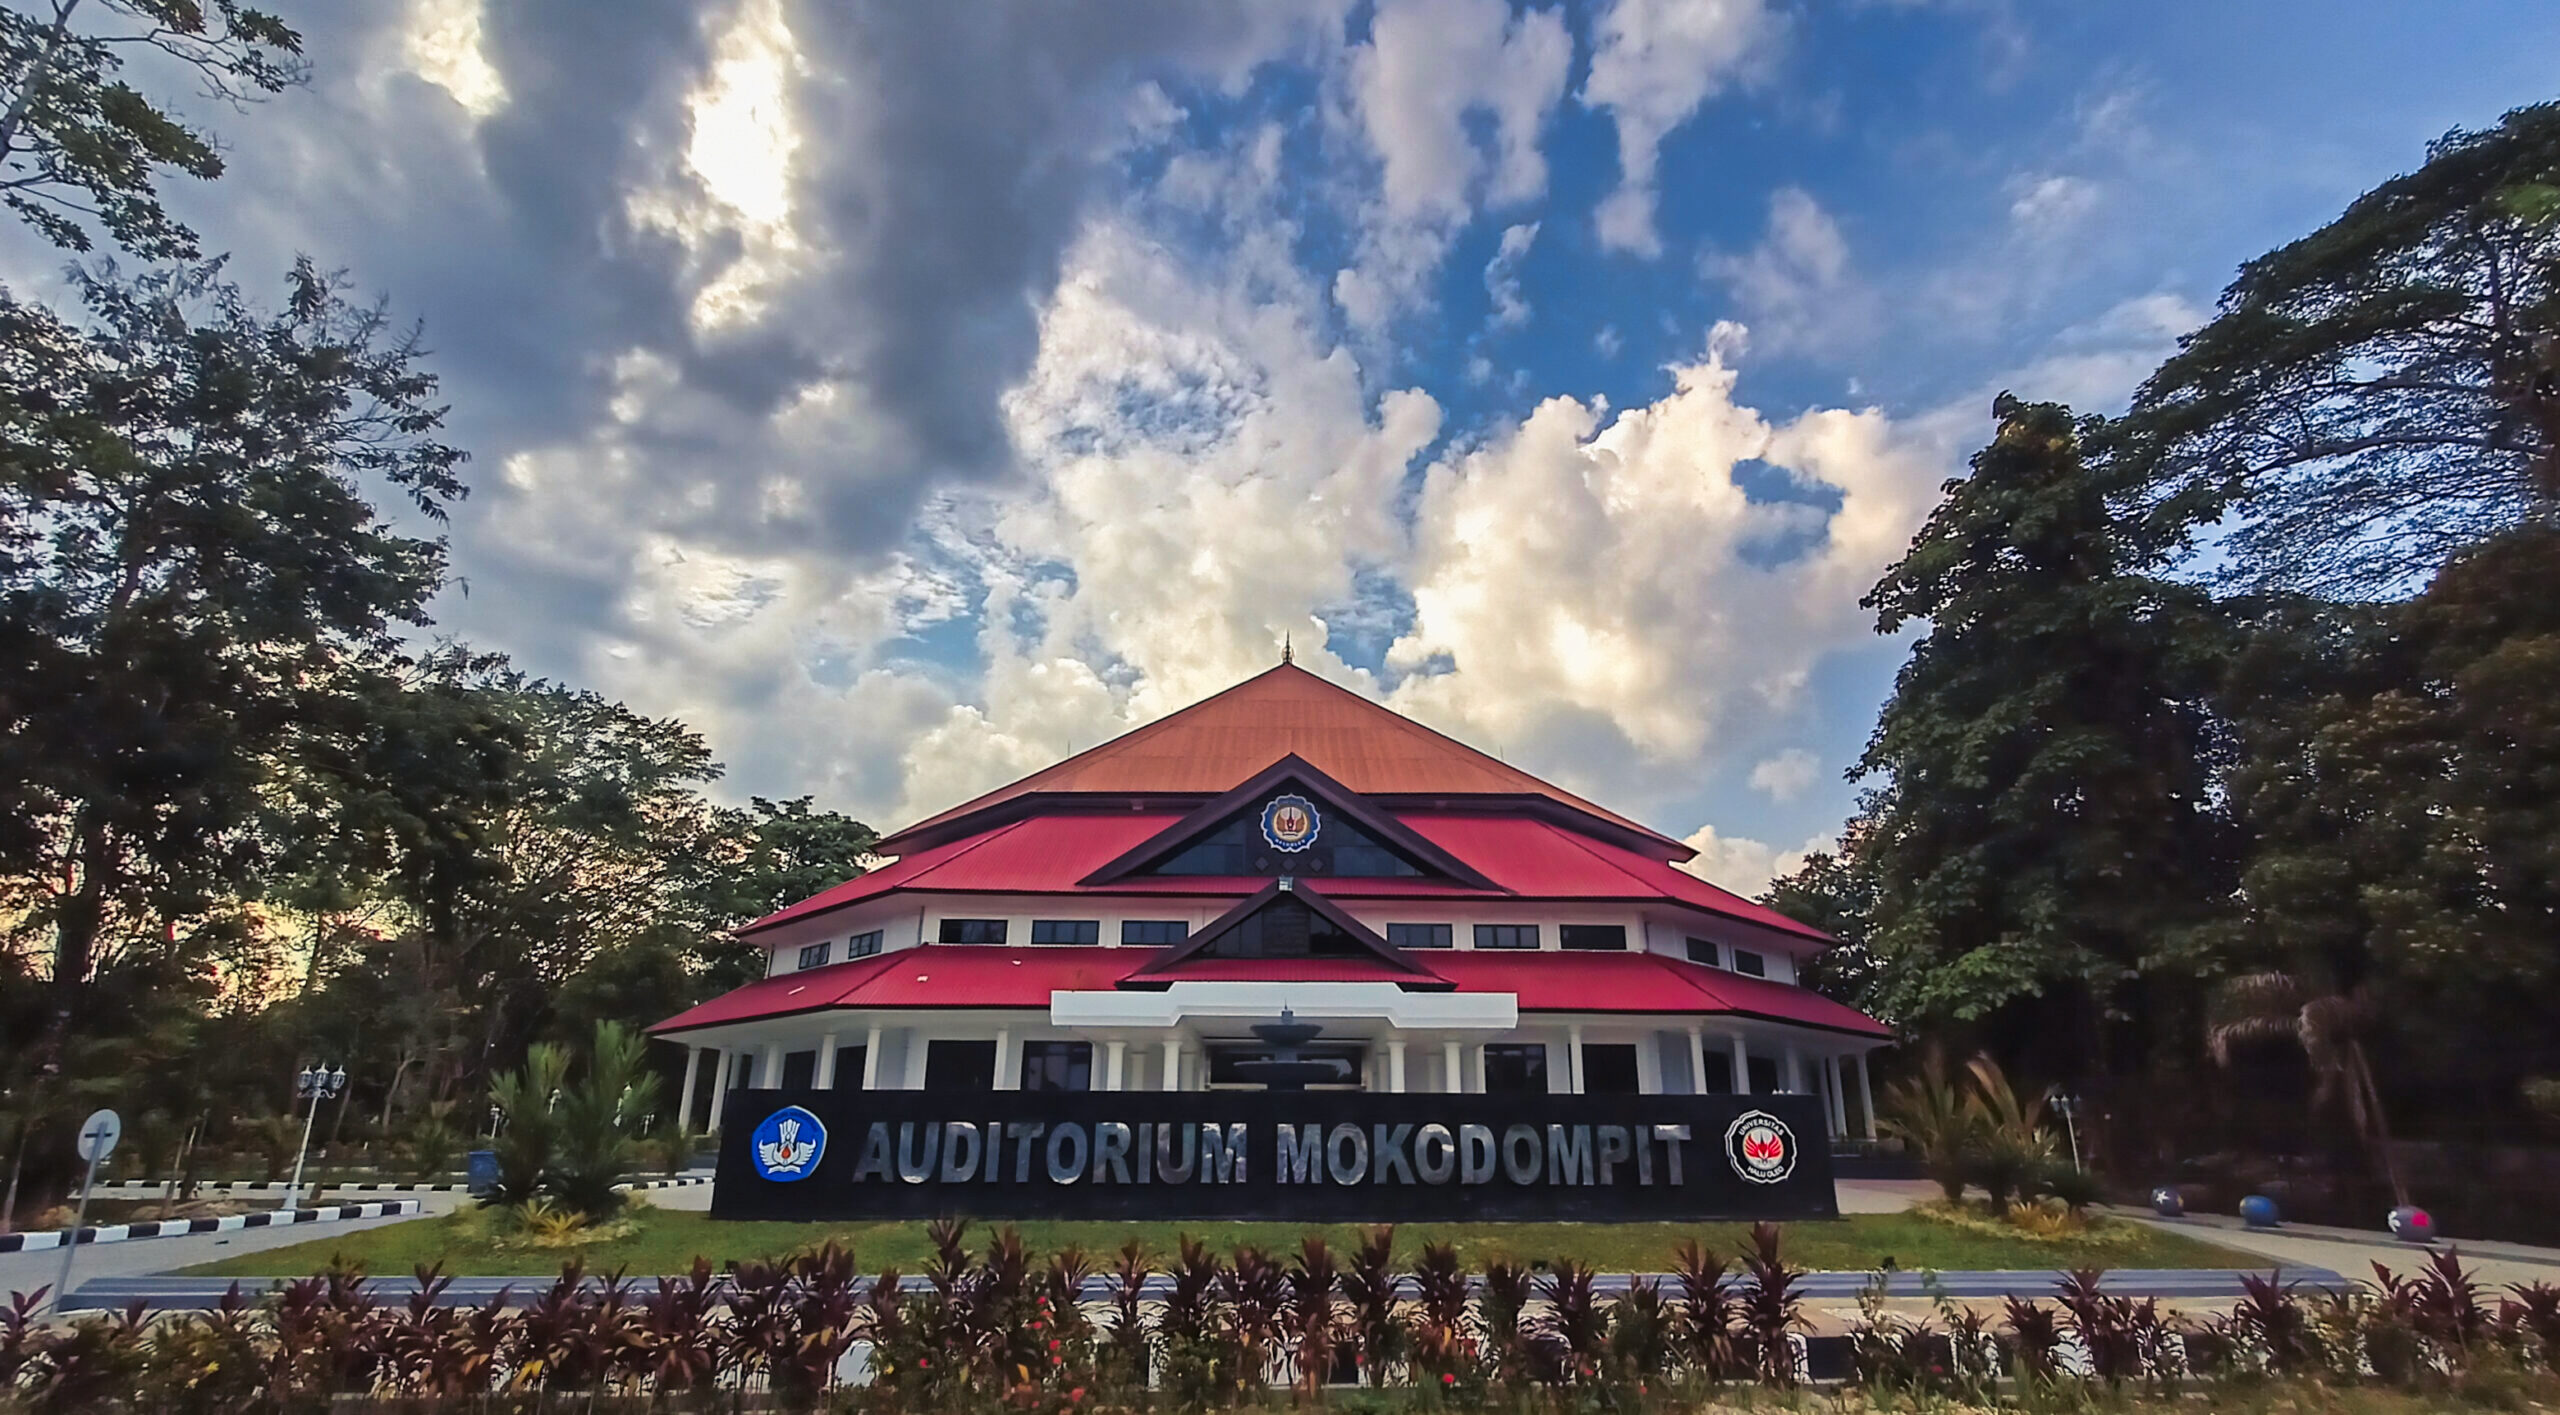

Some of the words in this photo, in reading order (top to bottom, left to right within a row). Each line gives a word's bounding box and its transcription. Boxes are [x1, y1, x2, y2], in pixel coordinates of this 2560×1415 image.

[1739, 1119, 1784, 1135] UNIVERSITAS
[852, 1121, 1247, 1184] AUDITORIUM
[1276, 1122, 1691, 1186] MOKODOMPIT
[1747, 1166, 1766, 1178] HALU
[1766, 1166, 1784, 1178] OLEO
